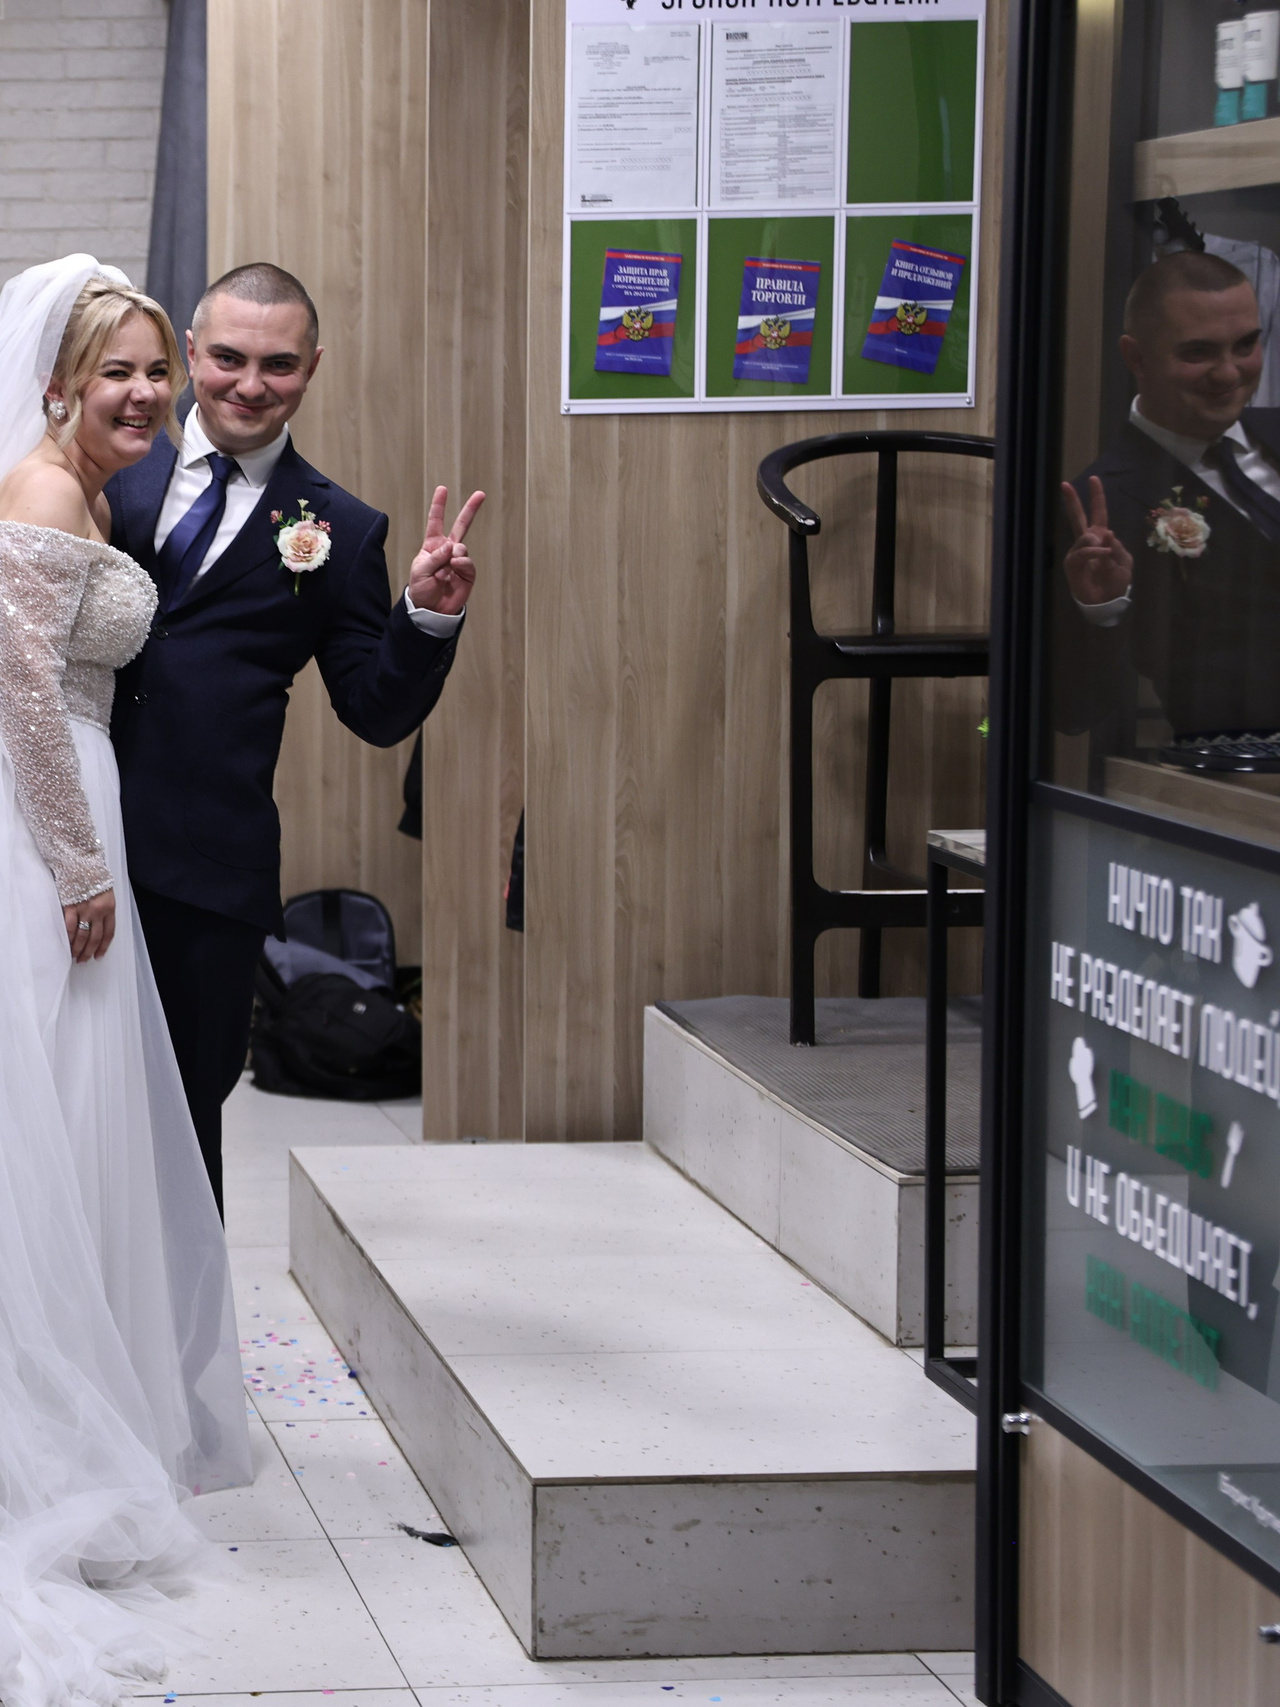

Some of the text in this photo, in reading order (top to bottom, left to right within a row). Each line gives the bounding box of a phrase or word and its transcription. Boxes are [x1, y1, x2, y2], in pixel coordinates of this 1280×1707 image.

[617, 265, 668, 277] ЗАЩИТА ПРАВ
[891, 267, 953, 290] И ПРЕДЛОЖЕНИЙ
[895, 259, 953, 280] КНИГА ОТЗЫВОВ
[613, 274, 670, 287] ПОТРЕБИТЕЛЕЙ
[756, 277, 804, 293] ПРАВИЛА
[751, 290, 807, 306] ТОРГОВЛИ
[1108, 862, 1223, 964] НИЧТО ТАК
[1051, 941, 1075, 1008] НЕ
[1079, 952, 1194, 1060] РАЗДЕЛЯЕТ
[1066, 1144, 1258, 1321] И НЕ ОБЪЕДИНЯЕТ,
